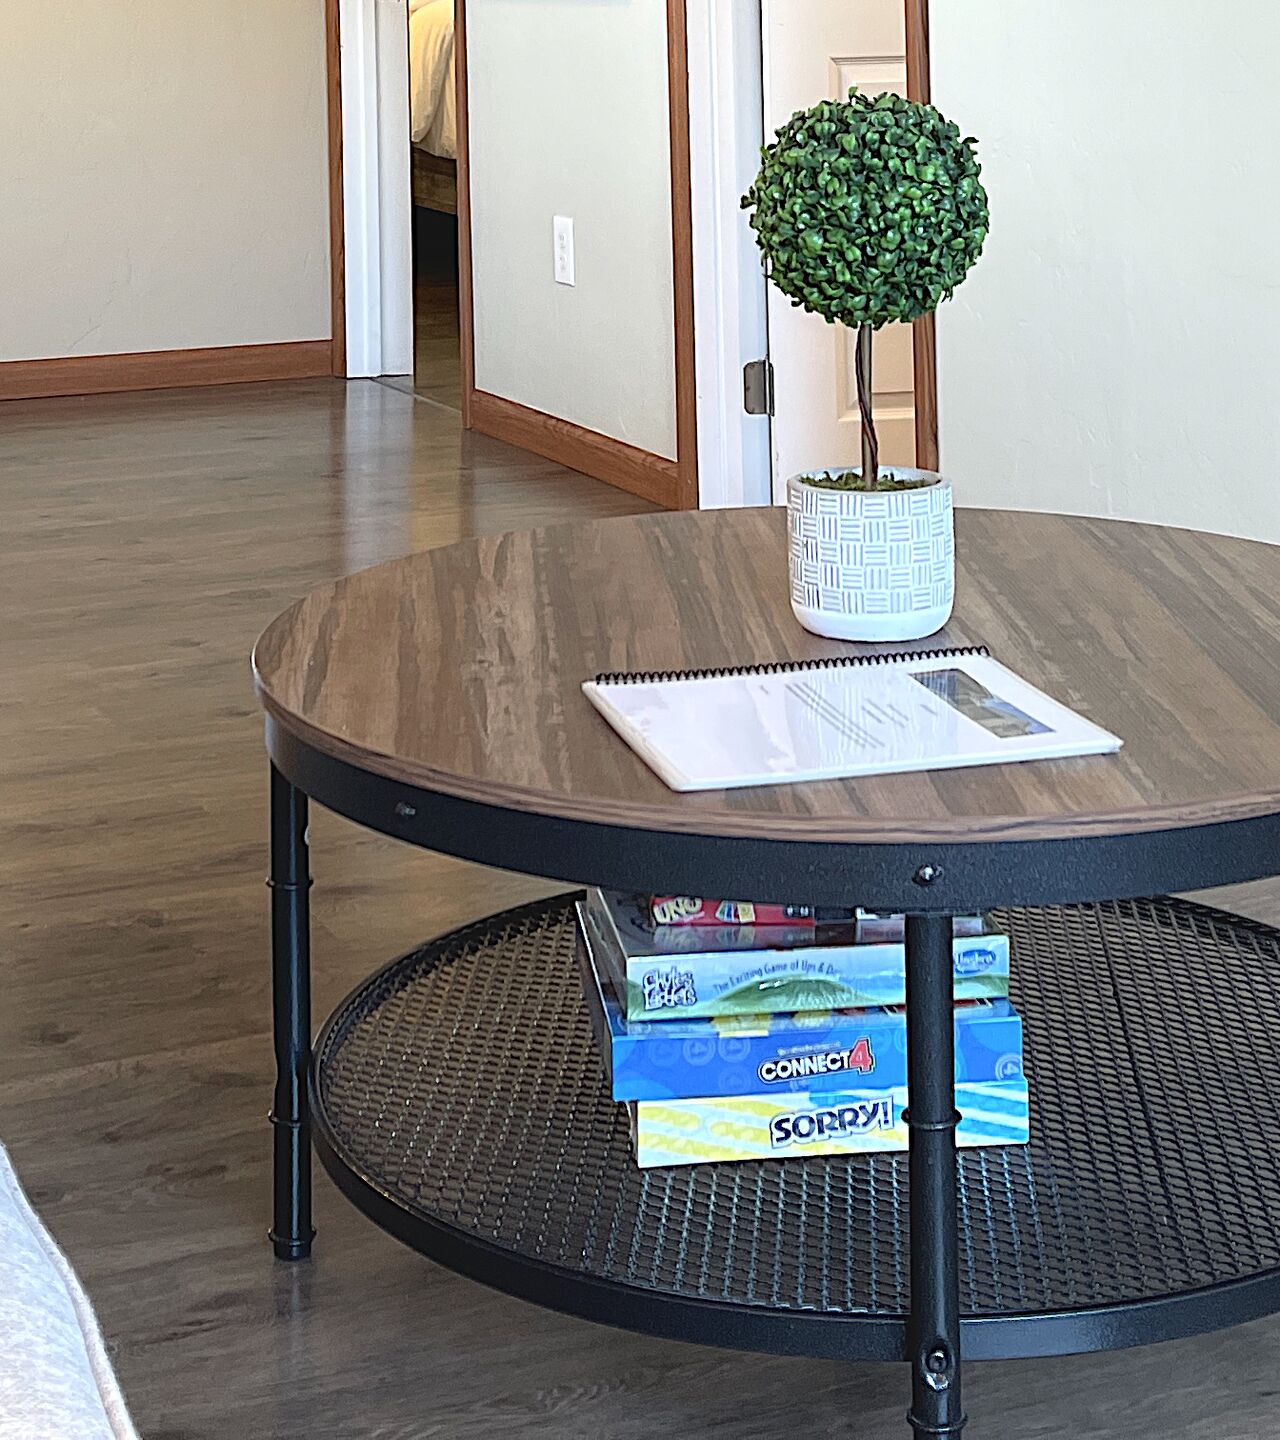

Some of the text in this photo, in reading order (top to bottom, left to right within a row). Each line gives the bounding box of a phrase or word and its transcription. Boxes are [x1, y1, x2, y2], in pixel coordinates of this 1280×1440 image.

[653, 896, 702, 924] UNO
[761, 1051, 851, 1081] CONNECT
[850, 1039, 873, 1072] 4
[774, 1102, 890, 1143] SORRY!
